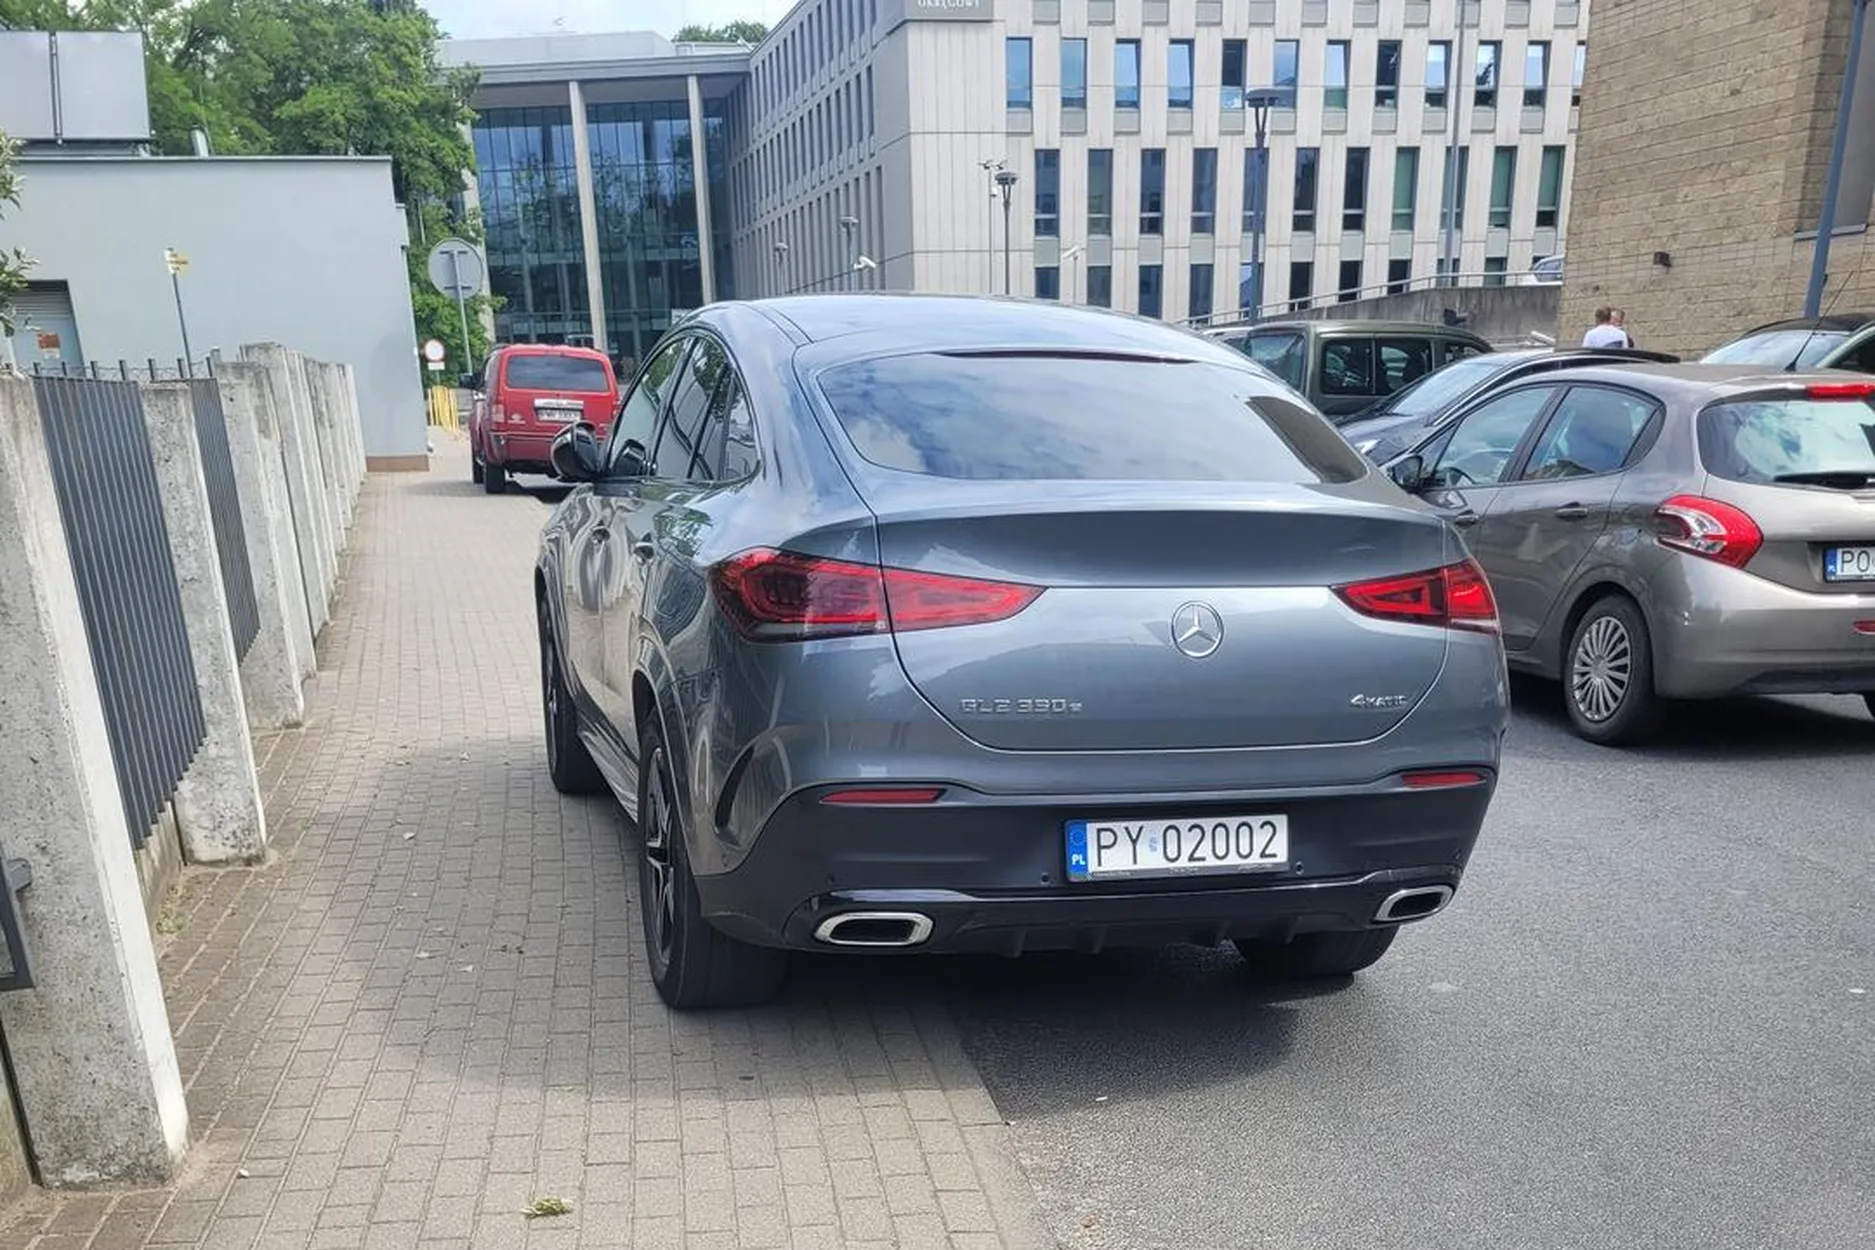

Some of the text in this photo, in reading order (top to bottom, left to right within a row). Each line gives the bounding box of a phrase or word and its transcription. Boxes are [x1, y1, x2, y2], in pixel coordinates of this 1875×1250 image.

[1096, 820, 1278, 867] PY 02002
[1072, 854, 1086, 866] PL
